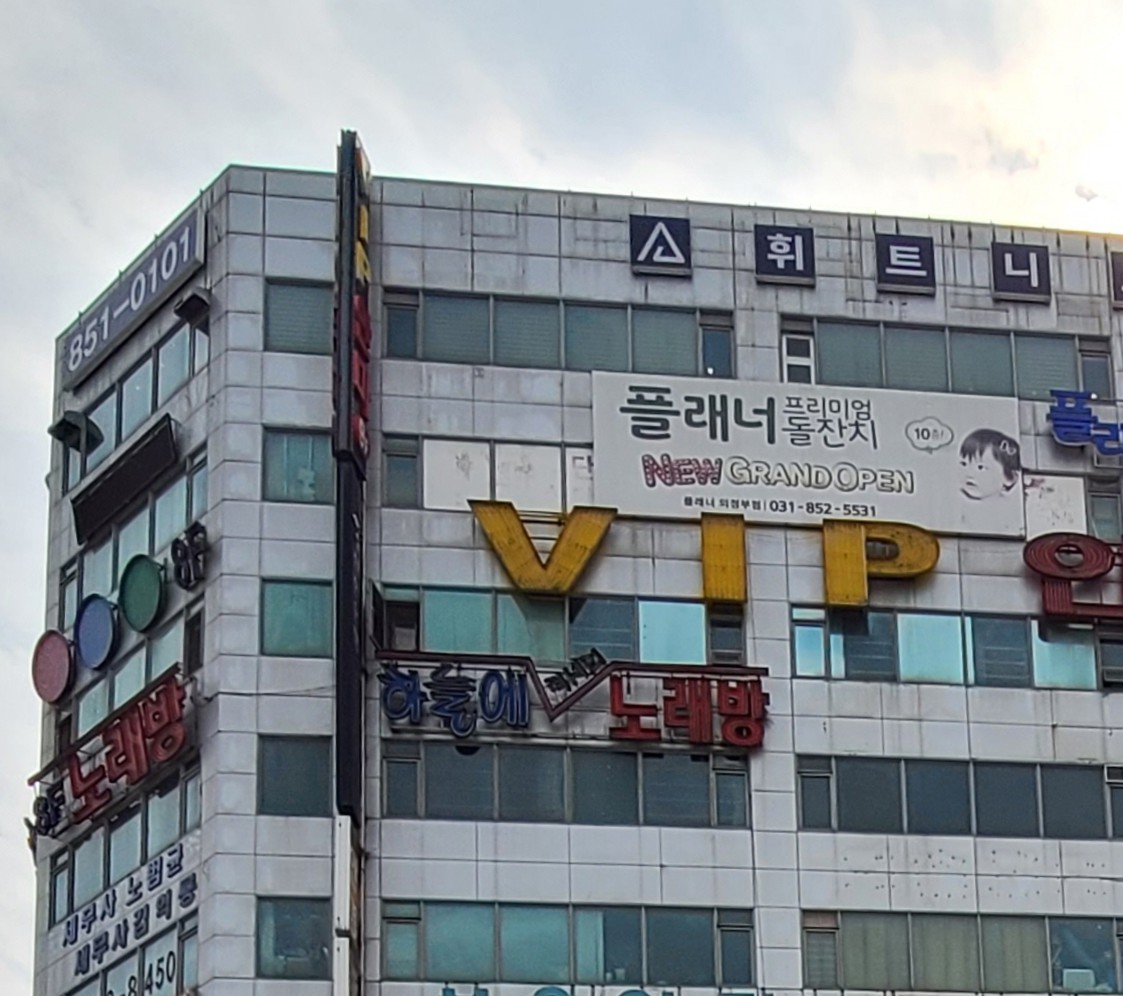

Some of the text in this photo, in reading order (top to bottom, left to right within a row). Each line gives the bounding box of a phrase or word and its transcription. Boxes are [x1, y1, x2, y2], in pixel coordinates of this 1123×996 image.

[67, 225, 193, 373] 851-0101
[619, 385, 777, 445] 플래너
[782, 396, 872, 422] 프리미엄
[782, 416, 879, 450] 돌잔치
[642, 453, 915, 495] NEW GRAND OPEN
[770, 501, 876, 517] 031-852-5531
[467, 499, 940, 607] VIP
